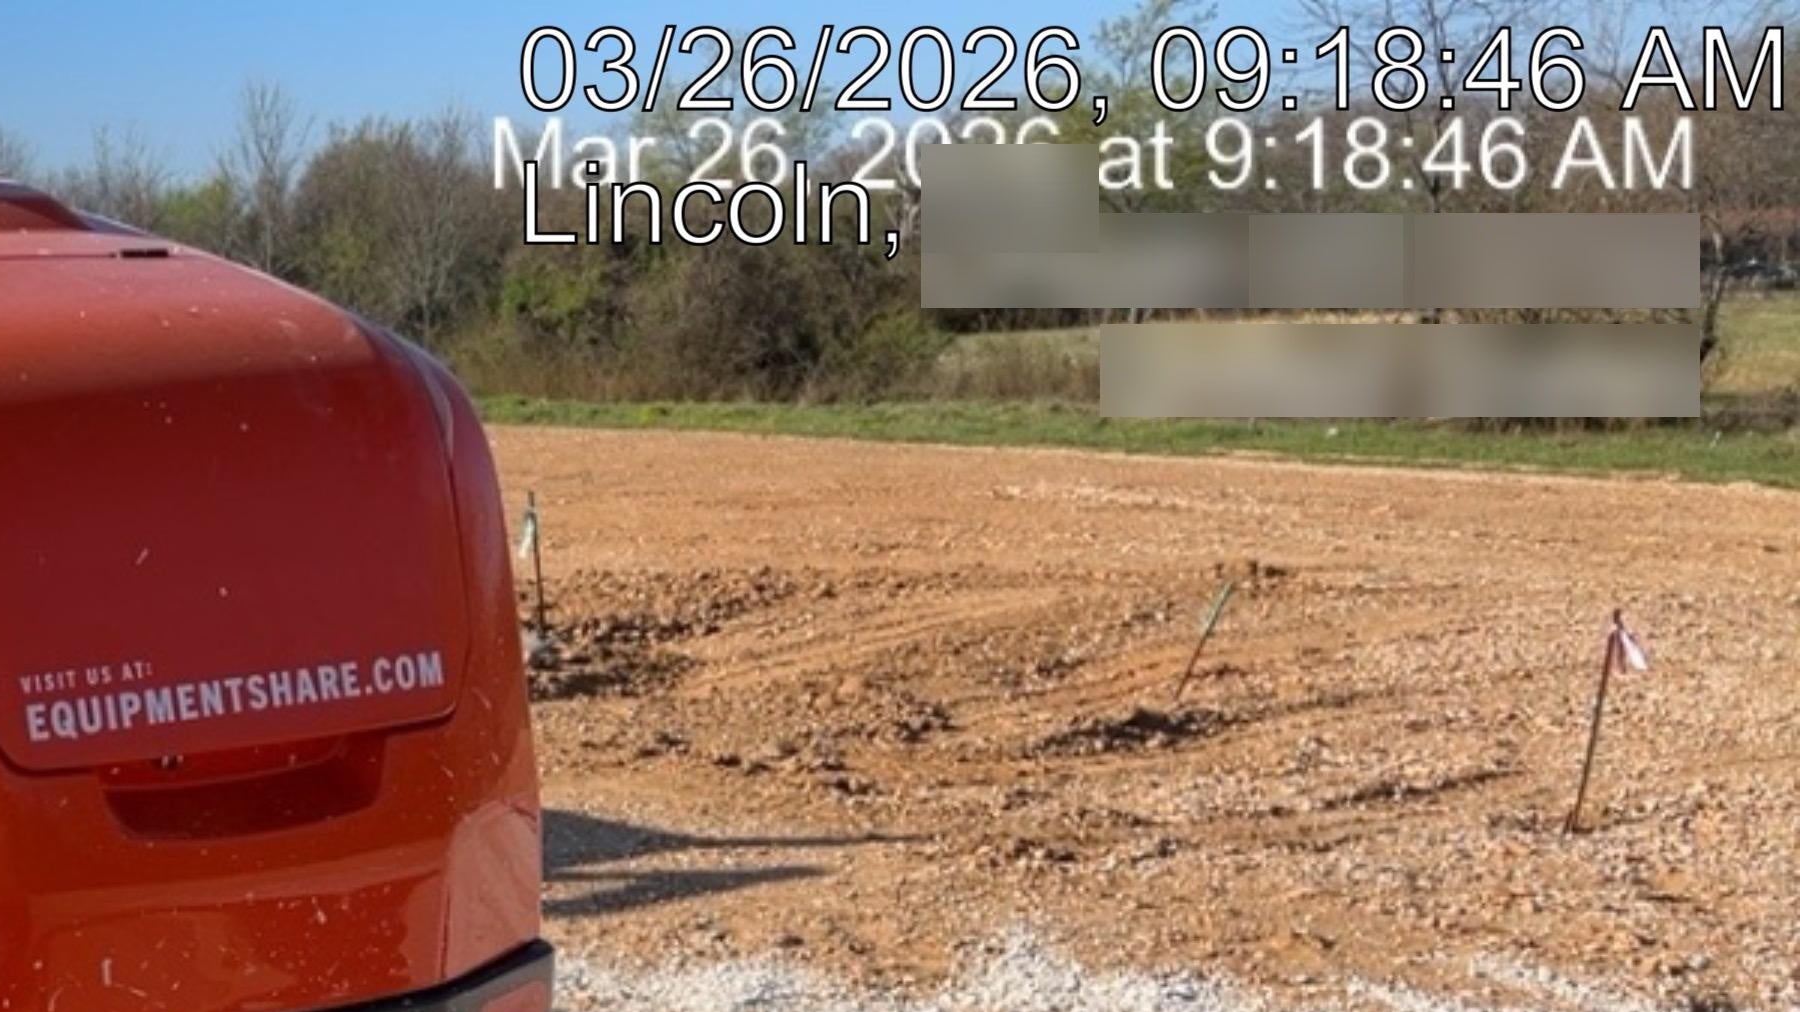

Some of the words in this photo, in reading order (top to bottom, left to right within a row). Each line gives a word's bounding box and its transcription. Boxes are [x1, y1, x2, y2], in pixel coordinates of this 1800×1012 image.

[19, 673, 76, 694] VISIT
[86, 666, 112, 684] US
[121, 661, 153, 681] AT:
[25, 651, 445, 743] EQUIPMENTSHARE.COM
